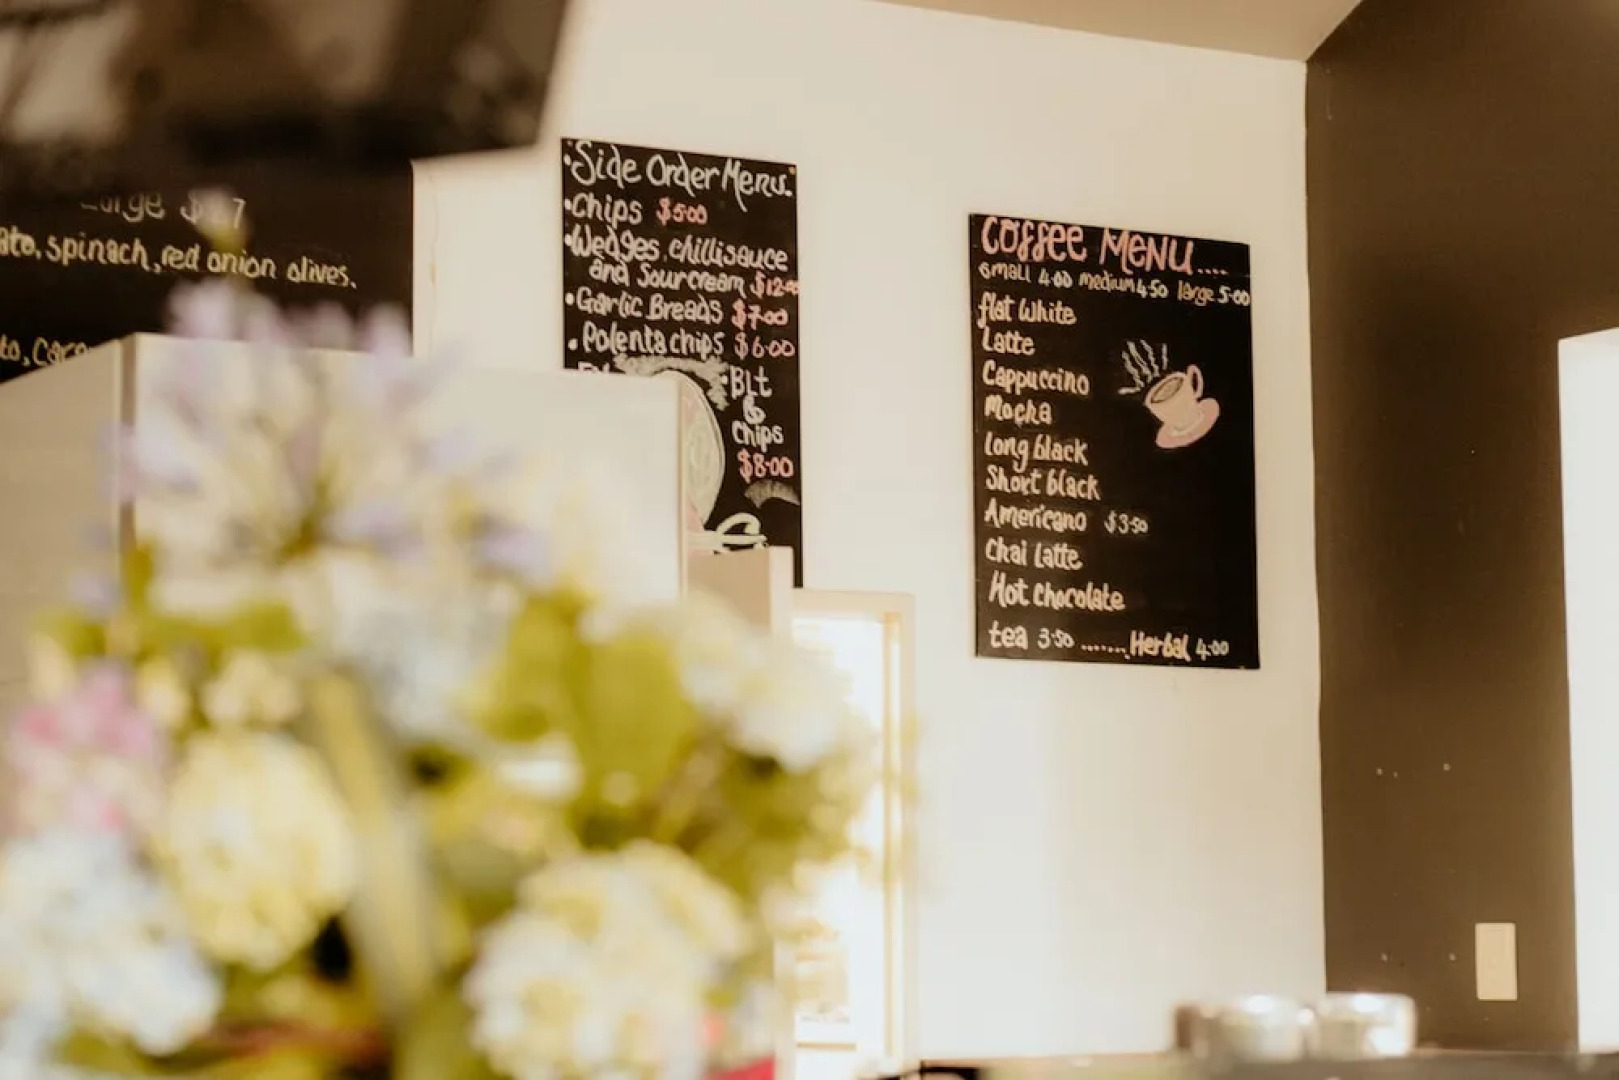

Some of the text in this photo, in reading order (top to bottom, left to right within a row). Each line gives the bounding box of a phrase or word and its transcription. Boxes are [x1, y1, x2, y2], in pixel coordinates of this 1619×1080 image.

[571, 140, 641, 189] Side
[646, 154, 719, 197] Order
[180, 189, 246, 229] $7
[207, 248, 276, 279] onion
[588, 258, 630, 287] and
[576, 286, 644, 318] Garlic
[645, 293, 724, 325] Breads
[1079, 270, 1136, 294] medium
[1177, 279, 1215, 306] large
[982, 359, 1091, 396] Cappuccino
[984, 395, 1053, 425] Mocha
[1032, 433, 1089, 467] black
[985, 464, 1101, 501] Short black
[984, 498, 1087, 532] Americano
[989, 569, 1030, 608] Hot
[988, 620, 1028, 650] tea
